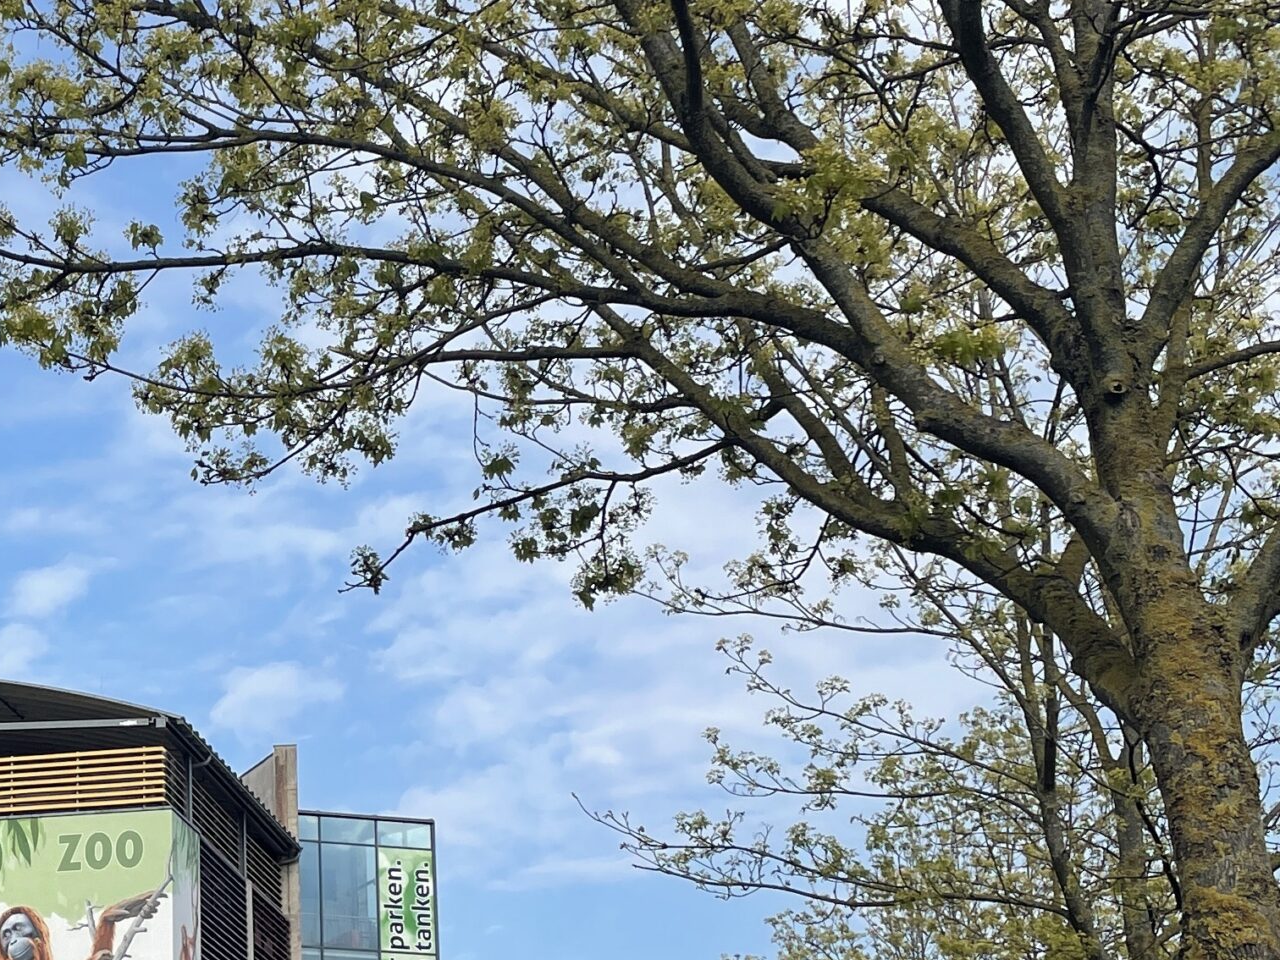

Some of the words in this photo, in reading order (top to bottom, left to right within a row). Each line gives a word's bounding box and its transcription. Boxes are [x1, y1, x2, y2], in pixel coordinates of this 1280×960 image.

[57, 830, 144, 872] ZOO
[384, 860, 410, 951] parken.
[412, 862, 433, 952] tanken.
